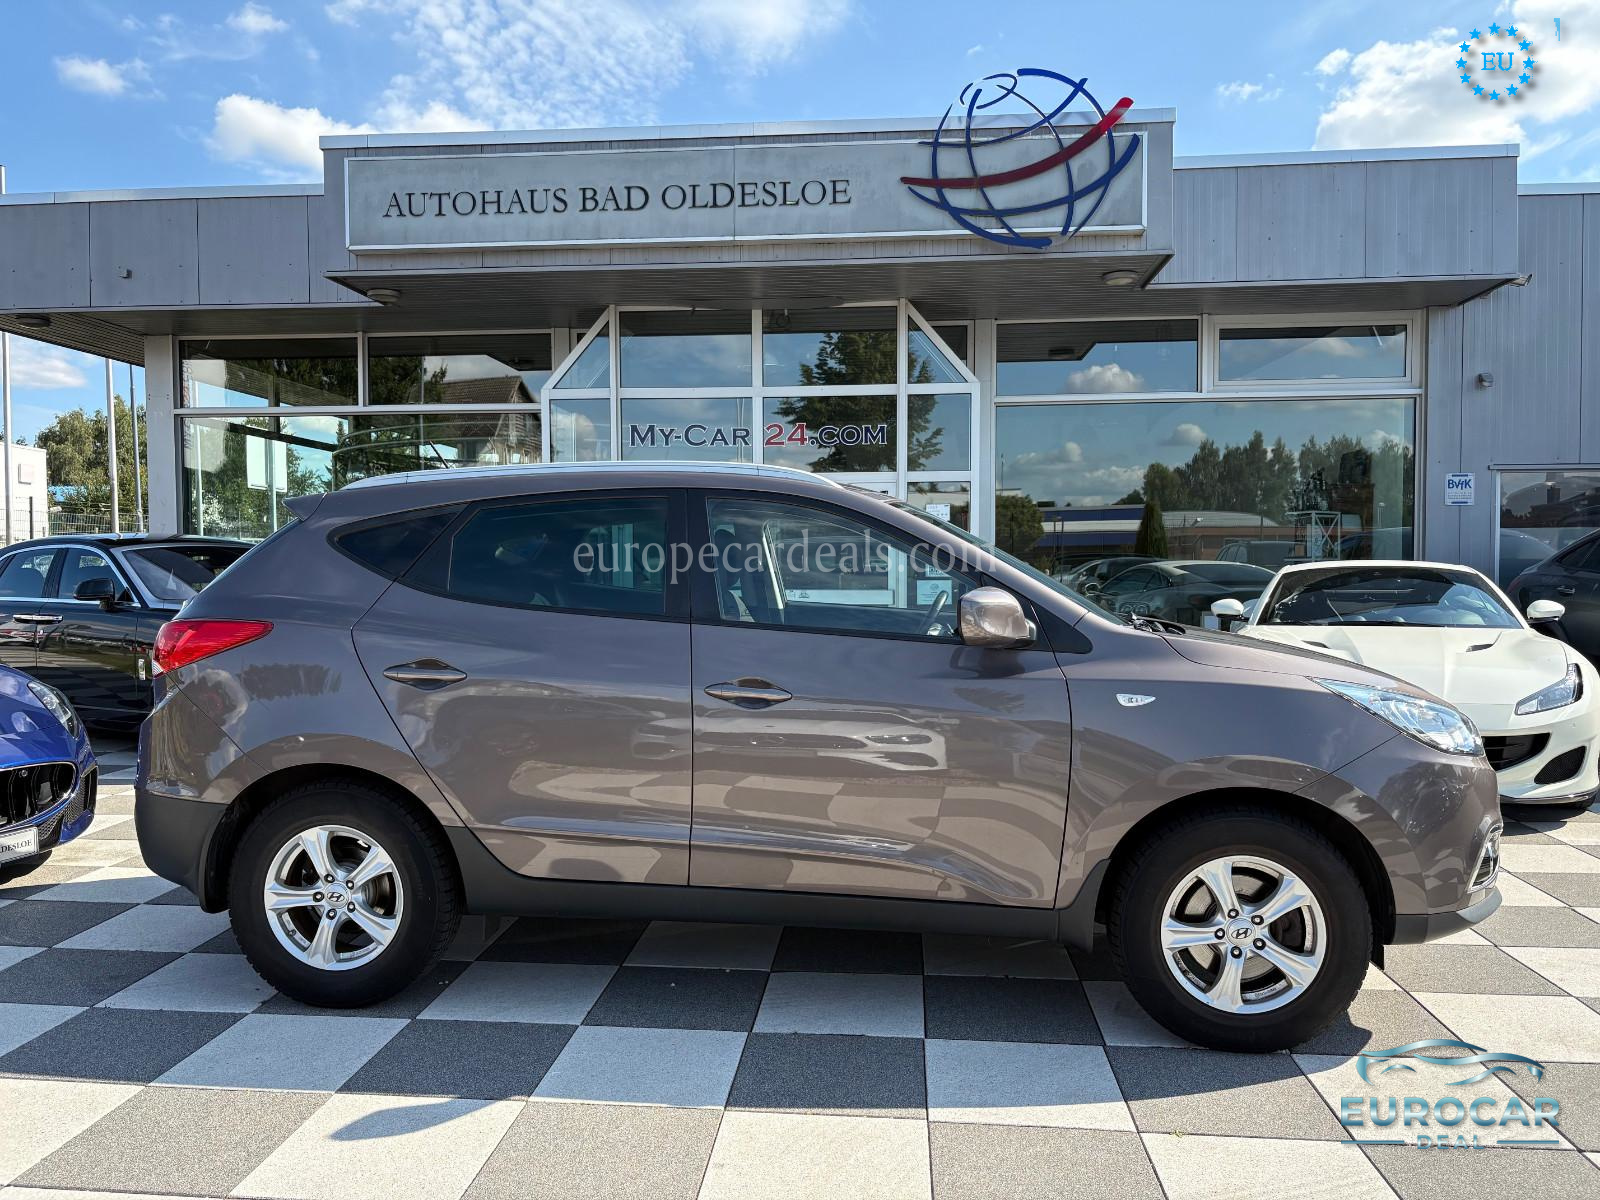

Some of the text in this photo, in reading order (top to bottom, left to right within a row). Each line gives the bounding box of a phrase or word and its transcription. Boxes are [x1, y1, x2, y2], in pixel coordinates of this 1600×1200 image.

[382, 179, 852, 219] AUTOHAUS BAD OLDESLOE
[0, 839, 33, 853] DESLOE
